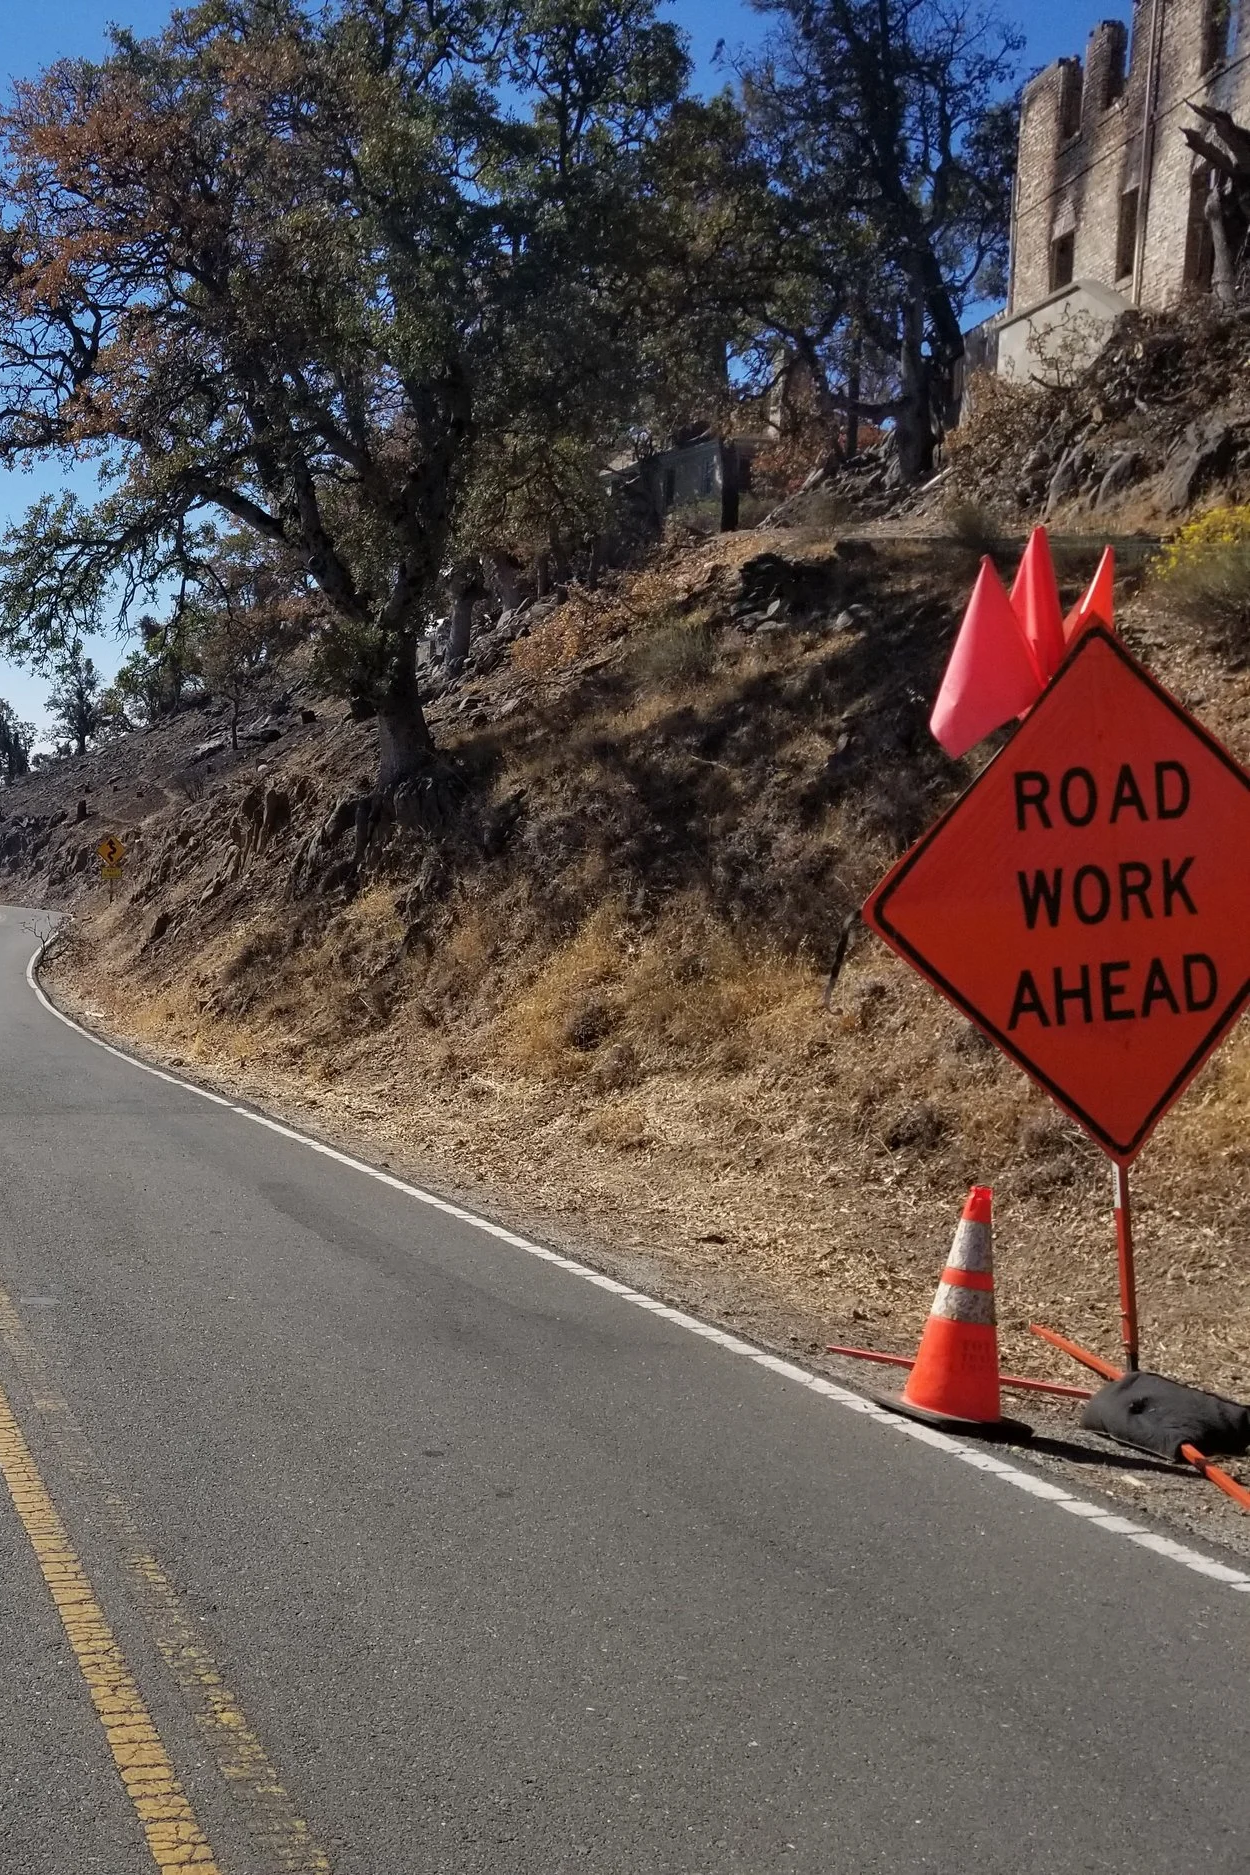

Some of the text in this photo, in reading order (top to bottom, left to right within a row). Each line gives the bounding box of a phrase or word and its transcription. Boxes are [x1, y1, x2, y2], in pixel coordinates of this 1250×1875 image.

[1013, 760, 1191, 832] ROAD
[1017, 856, 1198, 930] WORK
[1006, 952, 1219, 1032] AHEAD
